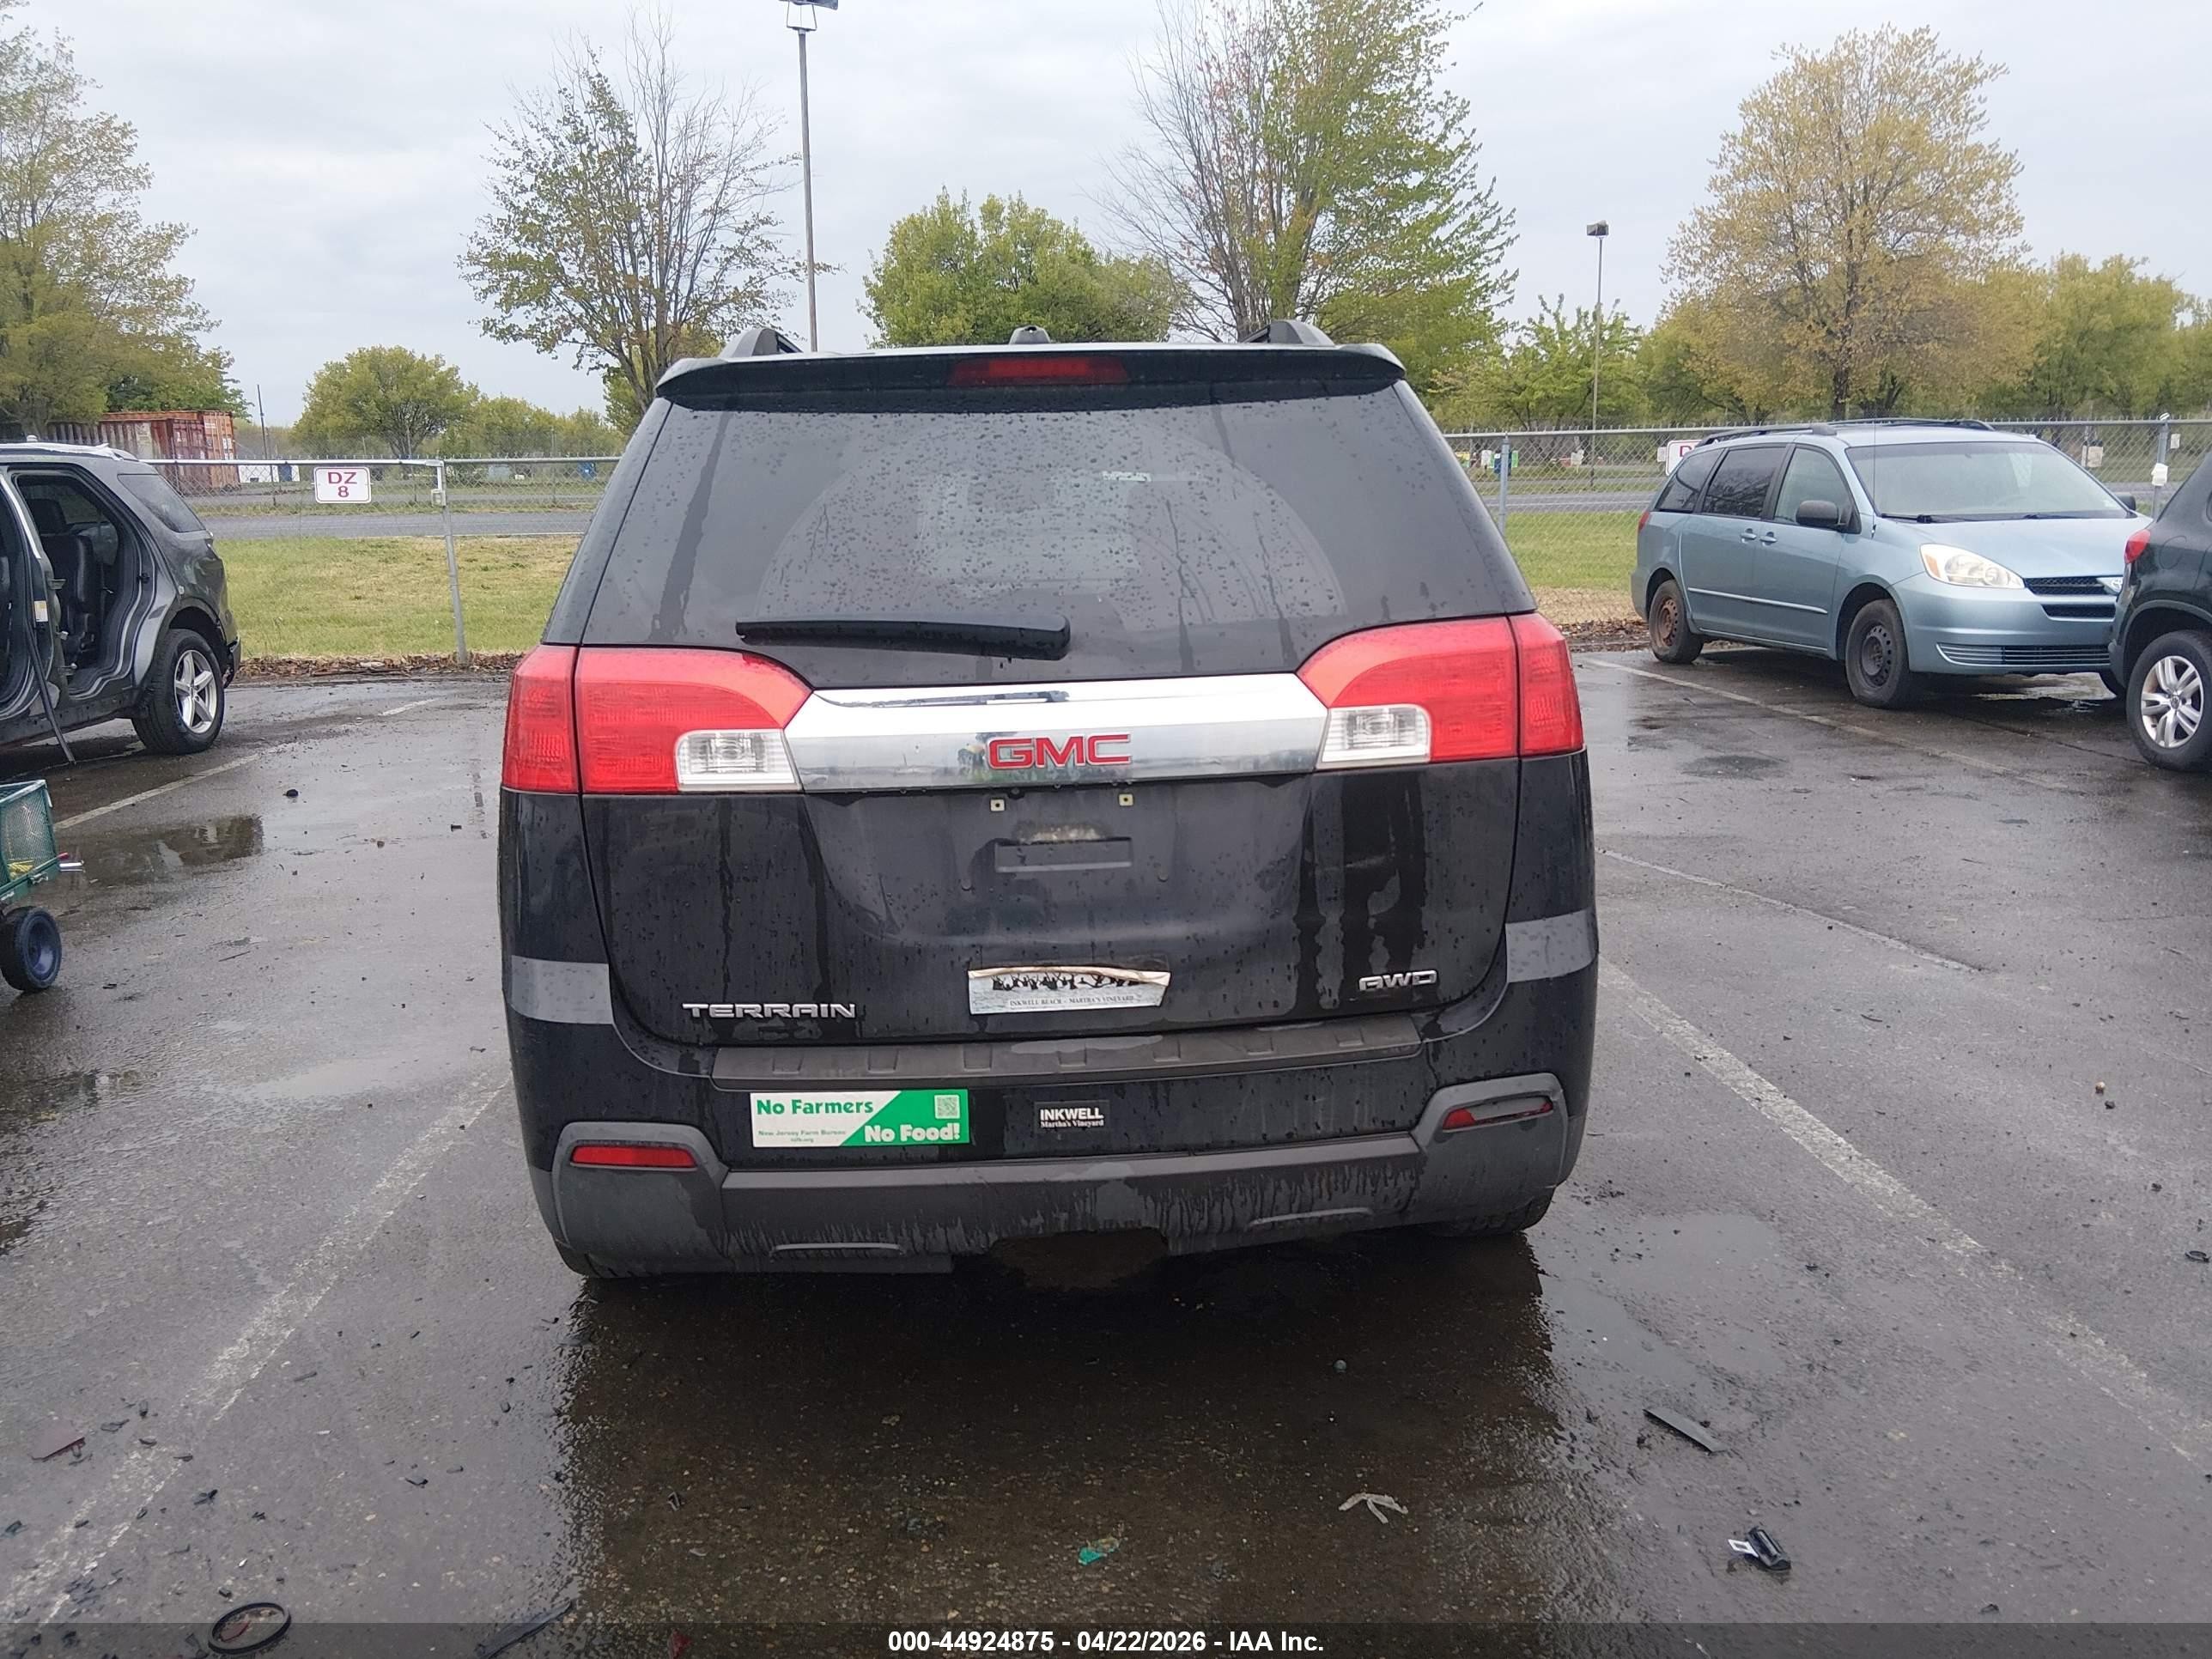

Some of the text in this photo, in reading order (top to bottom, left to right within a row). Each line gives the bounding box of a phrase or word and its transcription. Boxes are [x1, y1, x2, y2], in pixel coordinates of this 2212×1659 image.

[327, 471, 358, 484] DZ
[337, 485, 349, 498] 8
[988, 732, 1131, 769] GMC
[1358, 969, 1437, 991] AWD
[1009, 999, 1040, 1007] INKWELL
[1041, 998, 1063, 1006] BEACH
[1068, 996, 1101, 1005] MARTHA'S
[1102, 994, 1134, 1003] VINEYARD
[682, 1003, 855, 1018] TERRAIN
[757, 1098, 874, 1115] No Farmers
[1040, 1107, 1105, 1121] INKWELL
[1040, 1119, 1105, 1128] Martha's Vineyard
[864, 1122, 961, 1143] No Food!
